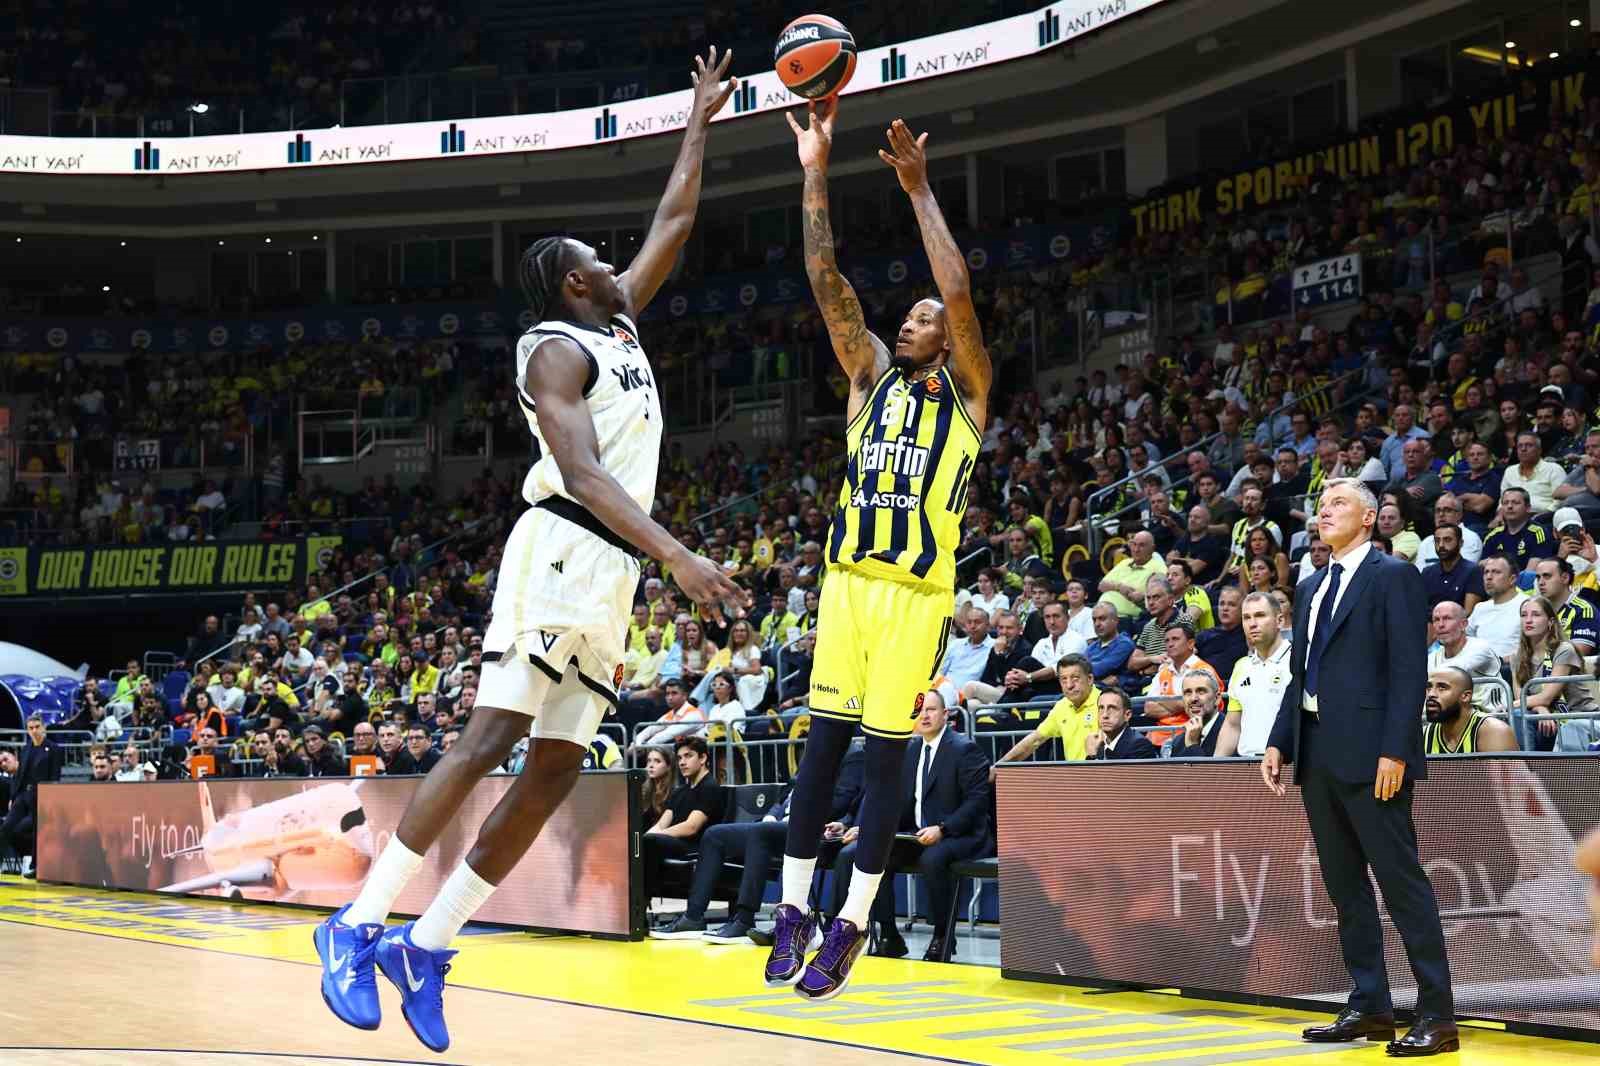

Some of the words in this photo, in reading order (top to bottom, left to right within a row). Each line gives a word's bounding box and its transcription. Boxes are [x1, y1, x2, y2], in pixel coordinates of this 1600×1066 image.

[1066, 11, 1092, 35] ANT
[913, 55, 947, 75] ANT
[625, 117, 653, 134] ANT
[473, 136, 505, 150] ANT
[2, 156, 38, 169] ANT
[168, 156, 200, 170] ANT
[319, 147, 350, 161] ANT
[1130, 187, 1201, 238] TÜRK
[1395, 116, 1453, 168] 120
[1319, 258, 1353, 280] 214
[1319, 278, 1354, 301] 114
[862, 435, 928, 476] tarfin
[869, 494, 917, 509] ASTOR
[36, 551, 85, 590] OUR
[88, 547, 165, 588] HOUSE
[168, 545, 218, 586] OUR
[221, 543, 297, 583] RULES
[817, 683, 839, 695] Hotels
[131, 813, 156, 868] Fly
[160, 818, 178, 861] to
[1170, 831, 1270, 946] Fly
